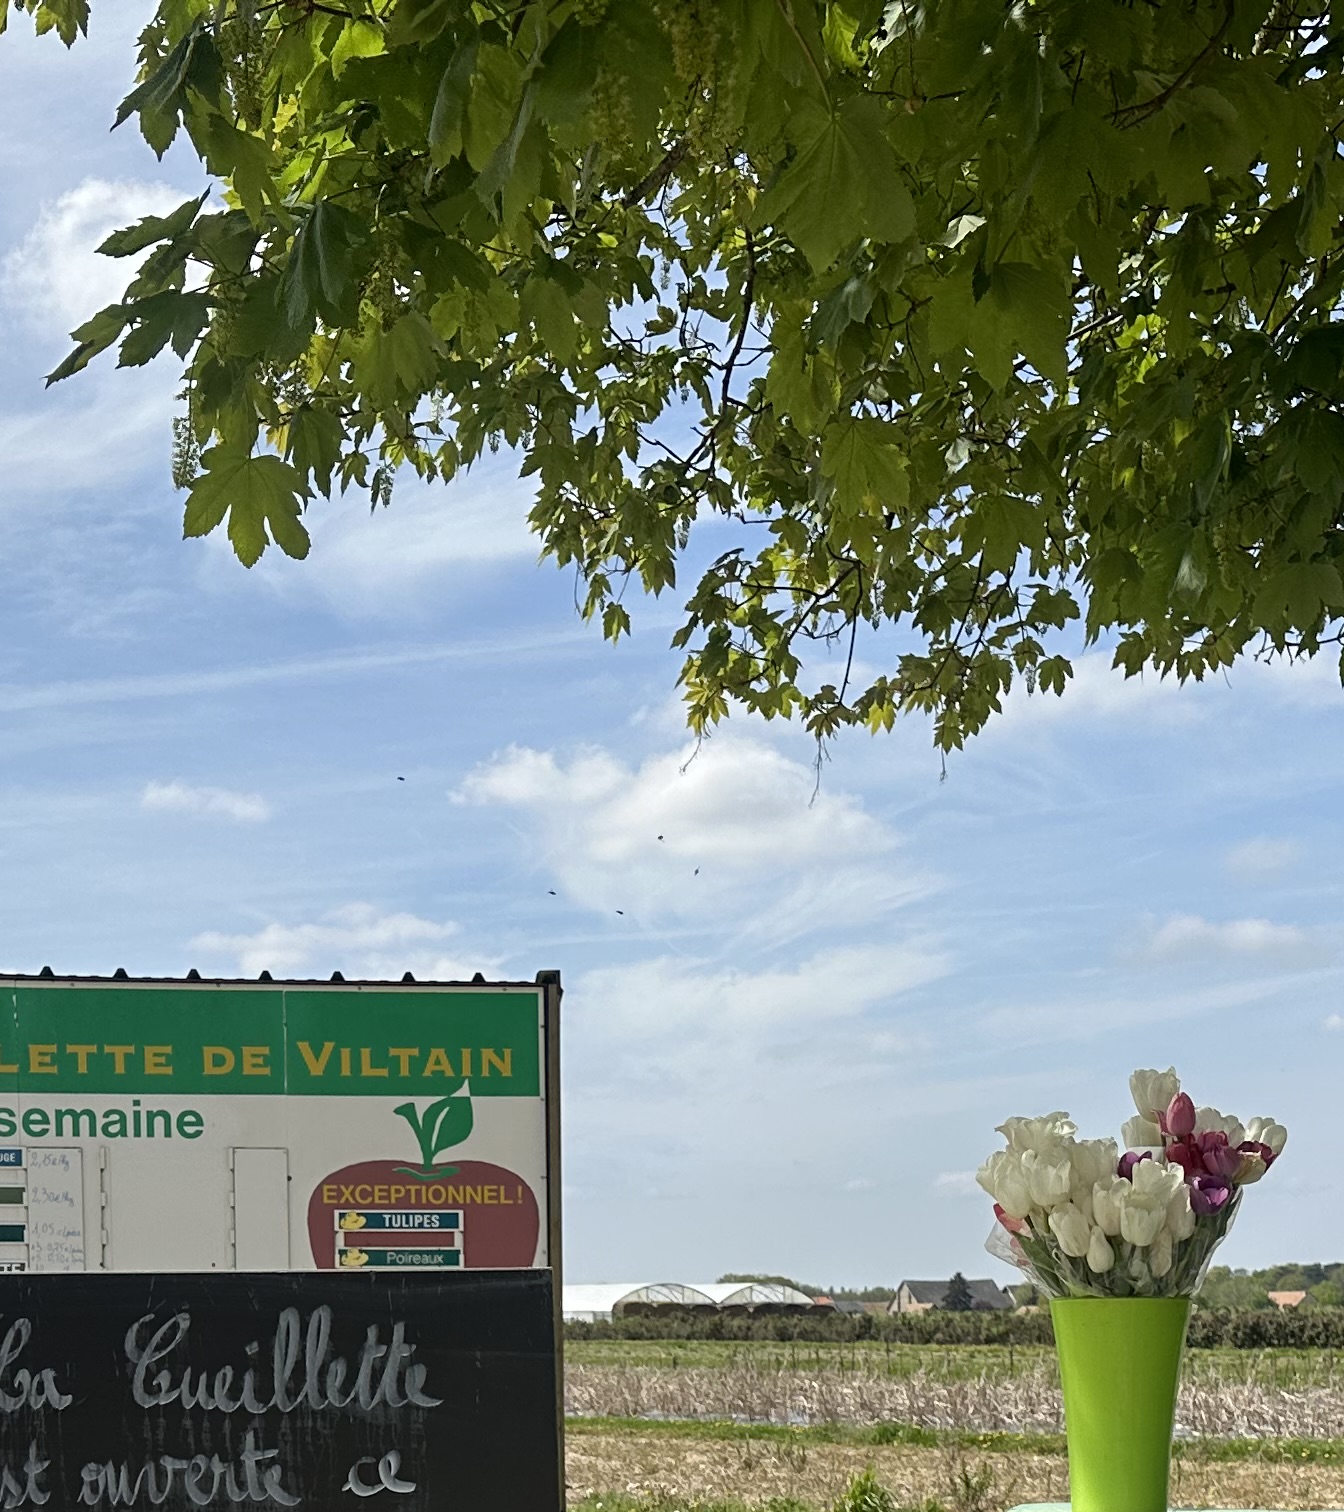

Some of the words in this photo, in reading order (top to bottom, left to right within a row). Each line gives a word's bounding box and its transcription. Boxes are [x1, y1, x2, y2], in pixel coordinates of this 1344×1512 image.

[203, 1046, 271, 1076] DE
[297, 1041, 513, 1078] VILTAIN
[382, 1214, 440, 1228] TULIPES
[386, 1252, 443, 1265] Poireaux
[124, 1304, 445, 1413] Cueillette
[77, 1430, 302, 1505] ouverte
[341, 1450, 417, 1497] ce
